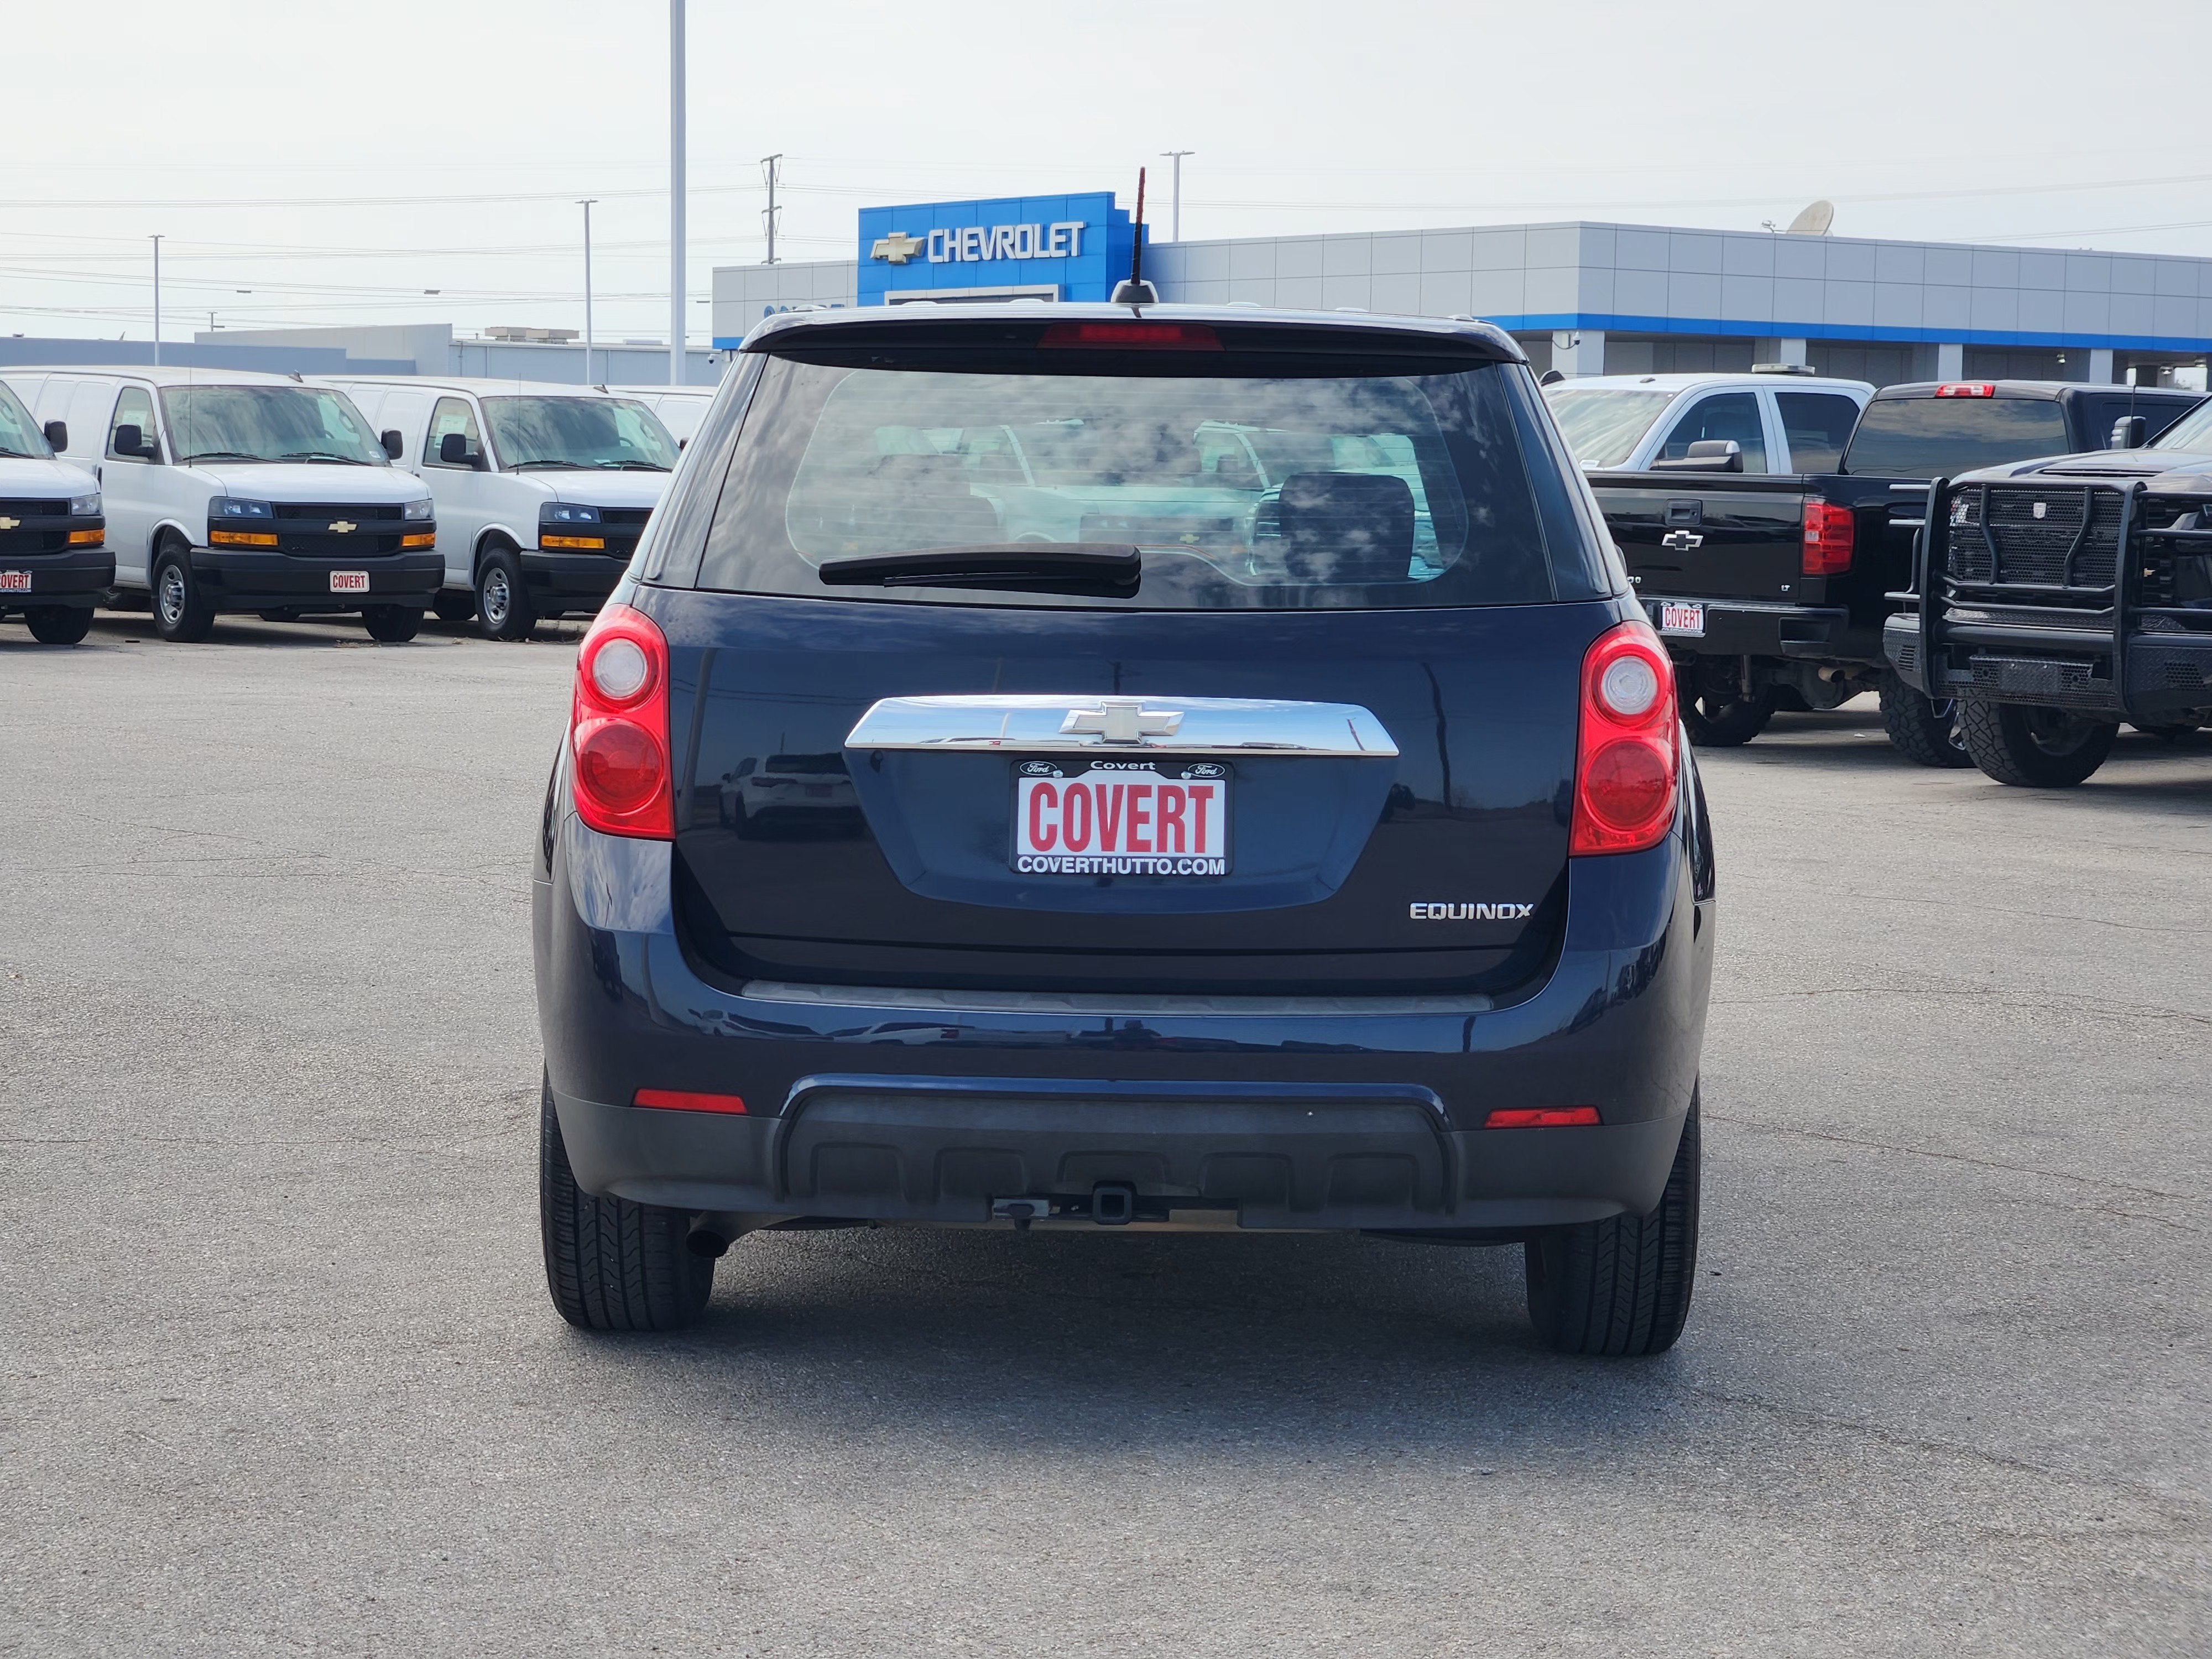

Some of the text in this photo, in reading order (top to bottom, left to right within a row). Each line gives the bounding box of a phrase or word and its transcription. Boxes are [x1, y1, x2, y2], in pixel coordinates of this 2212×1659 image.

[928, 221, 1085, 263] CHEVROLET
[0, 575, 29, 588] OVERT
[333, 575, 365, 588] COVERT
[1665, 607, 1700, 629] COVERT
[1090, 761, 1156, 770] Covert
[1029, 782, 1214, 853] COVERT
[1018, 857, 1225, 875] COVERTHUTTO.COM
[1410, 902, 1534, 920] EQUINOX
